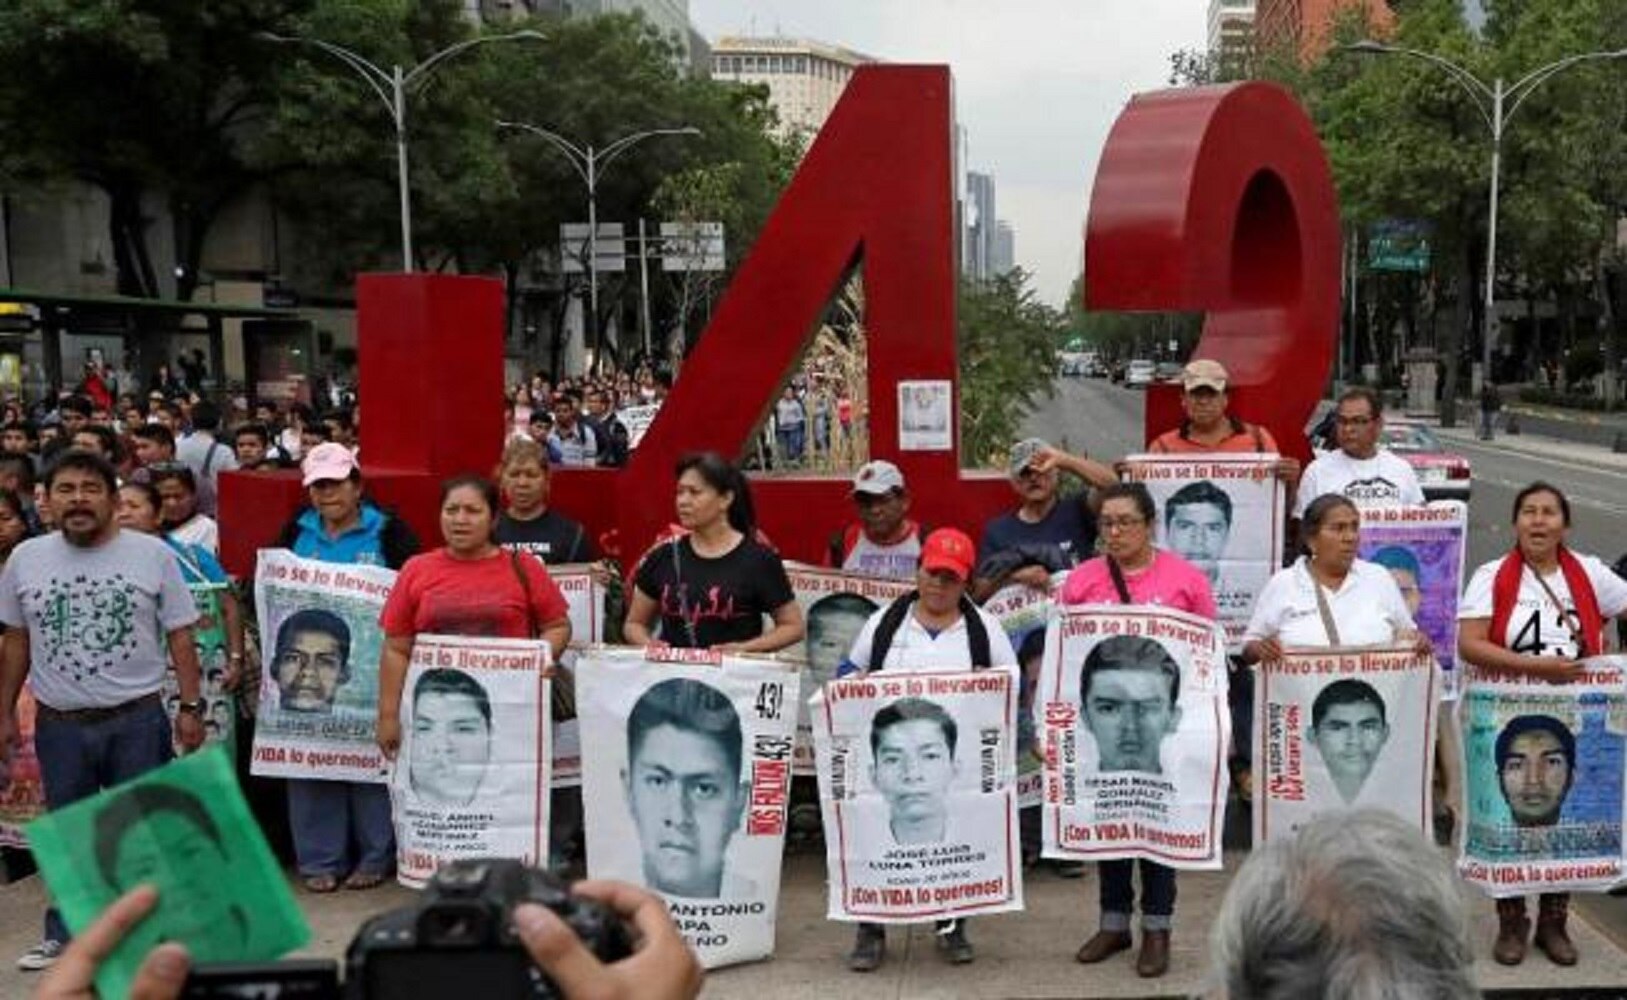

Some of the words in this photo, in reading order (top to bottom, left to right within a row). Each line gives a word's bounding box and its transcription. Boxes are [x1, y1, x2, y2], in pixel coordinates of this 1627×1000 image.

[1176, 466, 1191, 478] se
[1365, 509, 1380, 520] se
[290, 566, 309, 583] se
[1102, 619, 1121, 635] se
[1126, 618, 1141, 635] lo
[1511, 609, 1583, 660] 43
[437, 650, 453, 666] lo
[459, 650, 536, 669] llevaron!
[1315, 659, 1333, 673] se
[1340, 656, 1355, 672] lo
[882, 682, 901, 696] se
[907, 679, 923, 694] lo
[928, 675, 1005, 695] llevaron!
[290, 748, 303, 764] lo
[306, 751, 381, 769] queremos!
[1064, 823, 1091, 843] ¡Con
[1095, 823, 1130, 841] VIDA
[1491, 867, 1525, 884] VIDA
[1528, 866, 1542, 881] lo
[852, 887, 878, 906] ¡Con
[882, 888, 913, 905] VIDA
[917, 887, 930, 902] lo
[934, 877, 1003, 905] queremos!
[669, 902, 766, 916] ANTONIO
